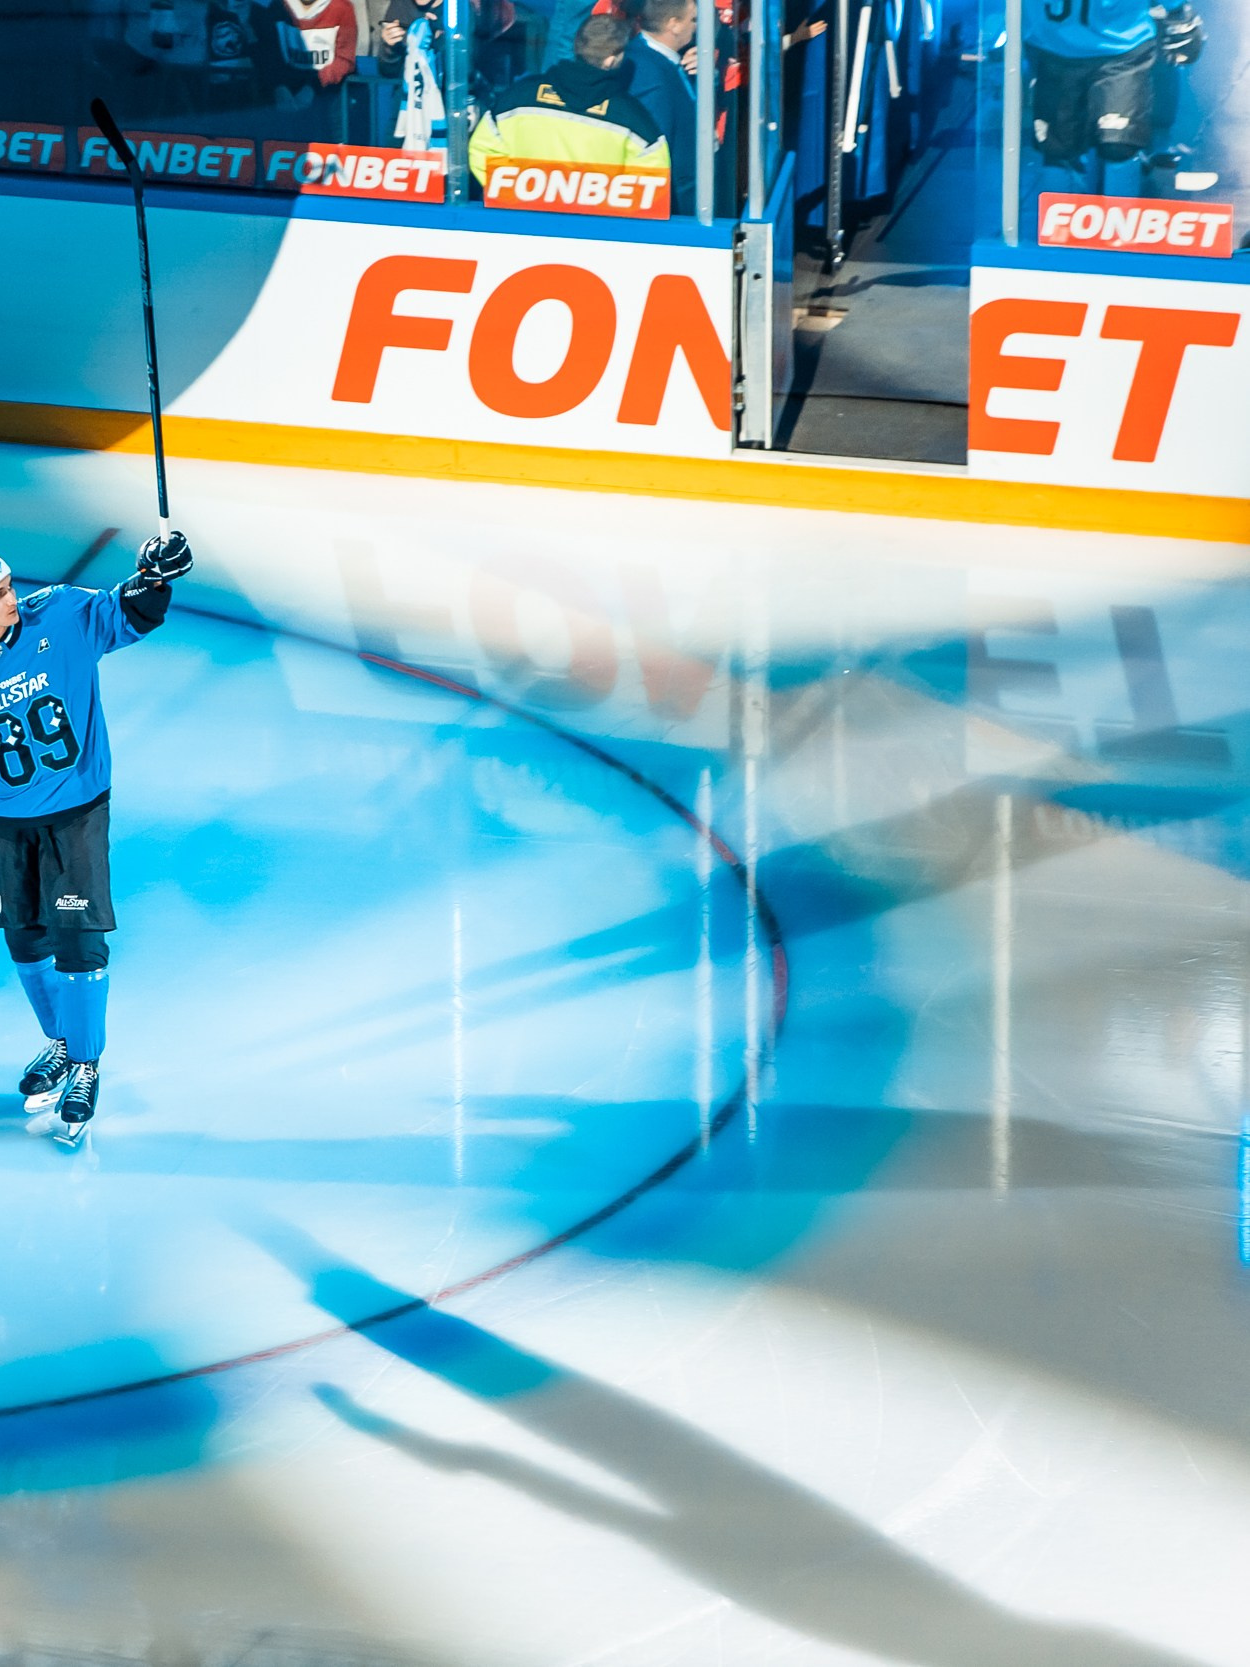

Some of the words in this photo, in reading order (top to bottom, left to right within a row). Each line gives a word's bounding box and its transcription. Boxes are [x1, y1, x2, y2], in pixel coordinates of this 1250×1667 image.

[80, 136, 253, 179] FONBET
[265, 150, 442, 194] FONBET
[487, 165, 667, 211] FONBET
[1040, 202, 1230, 248] FONBET
